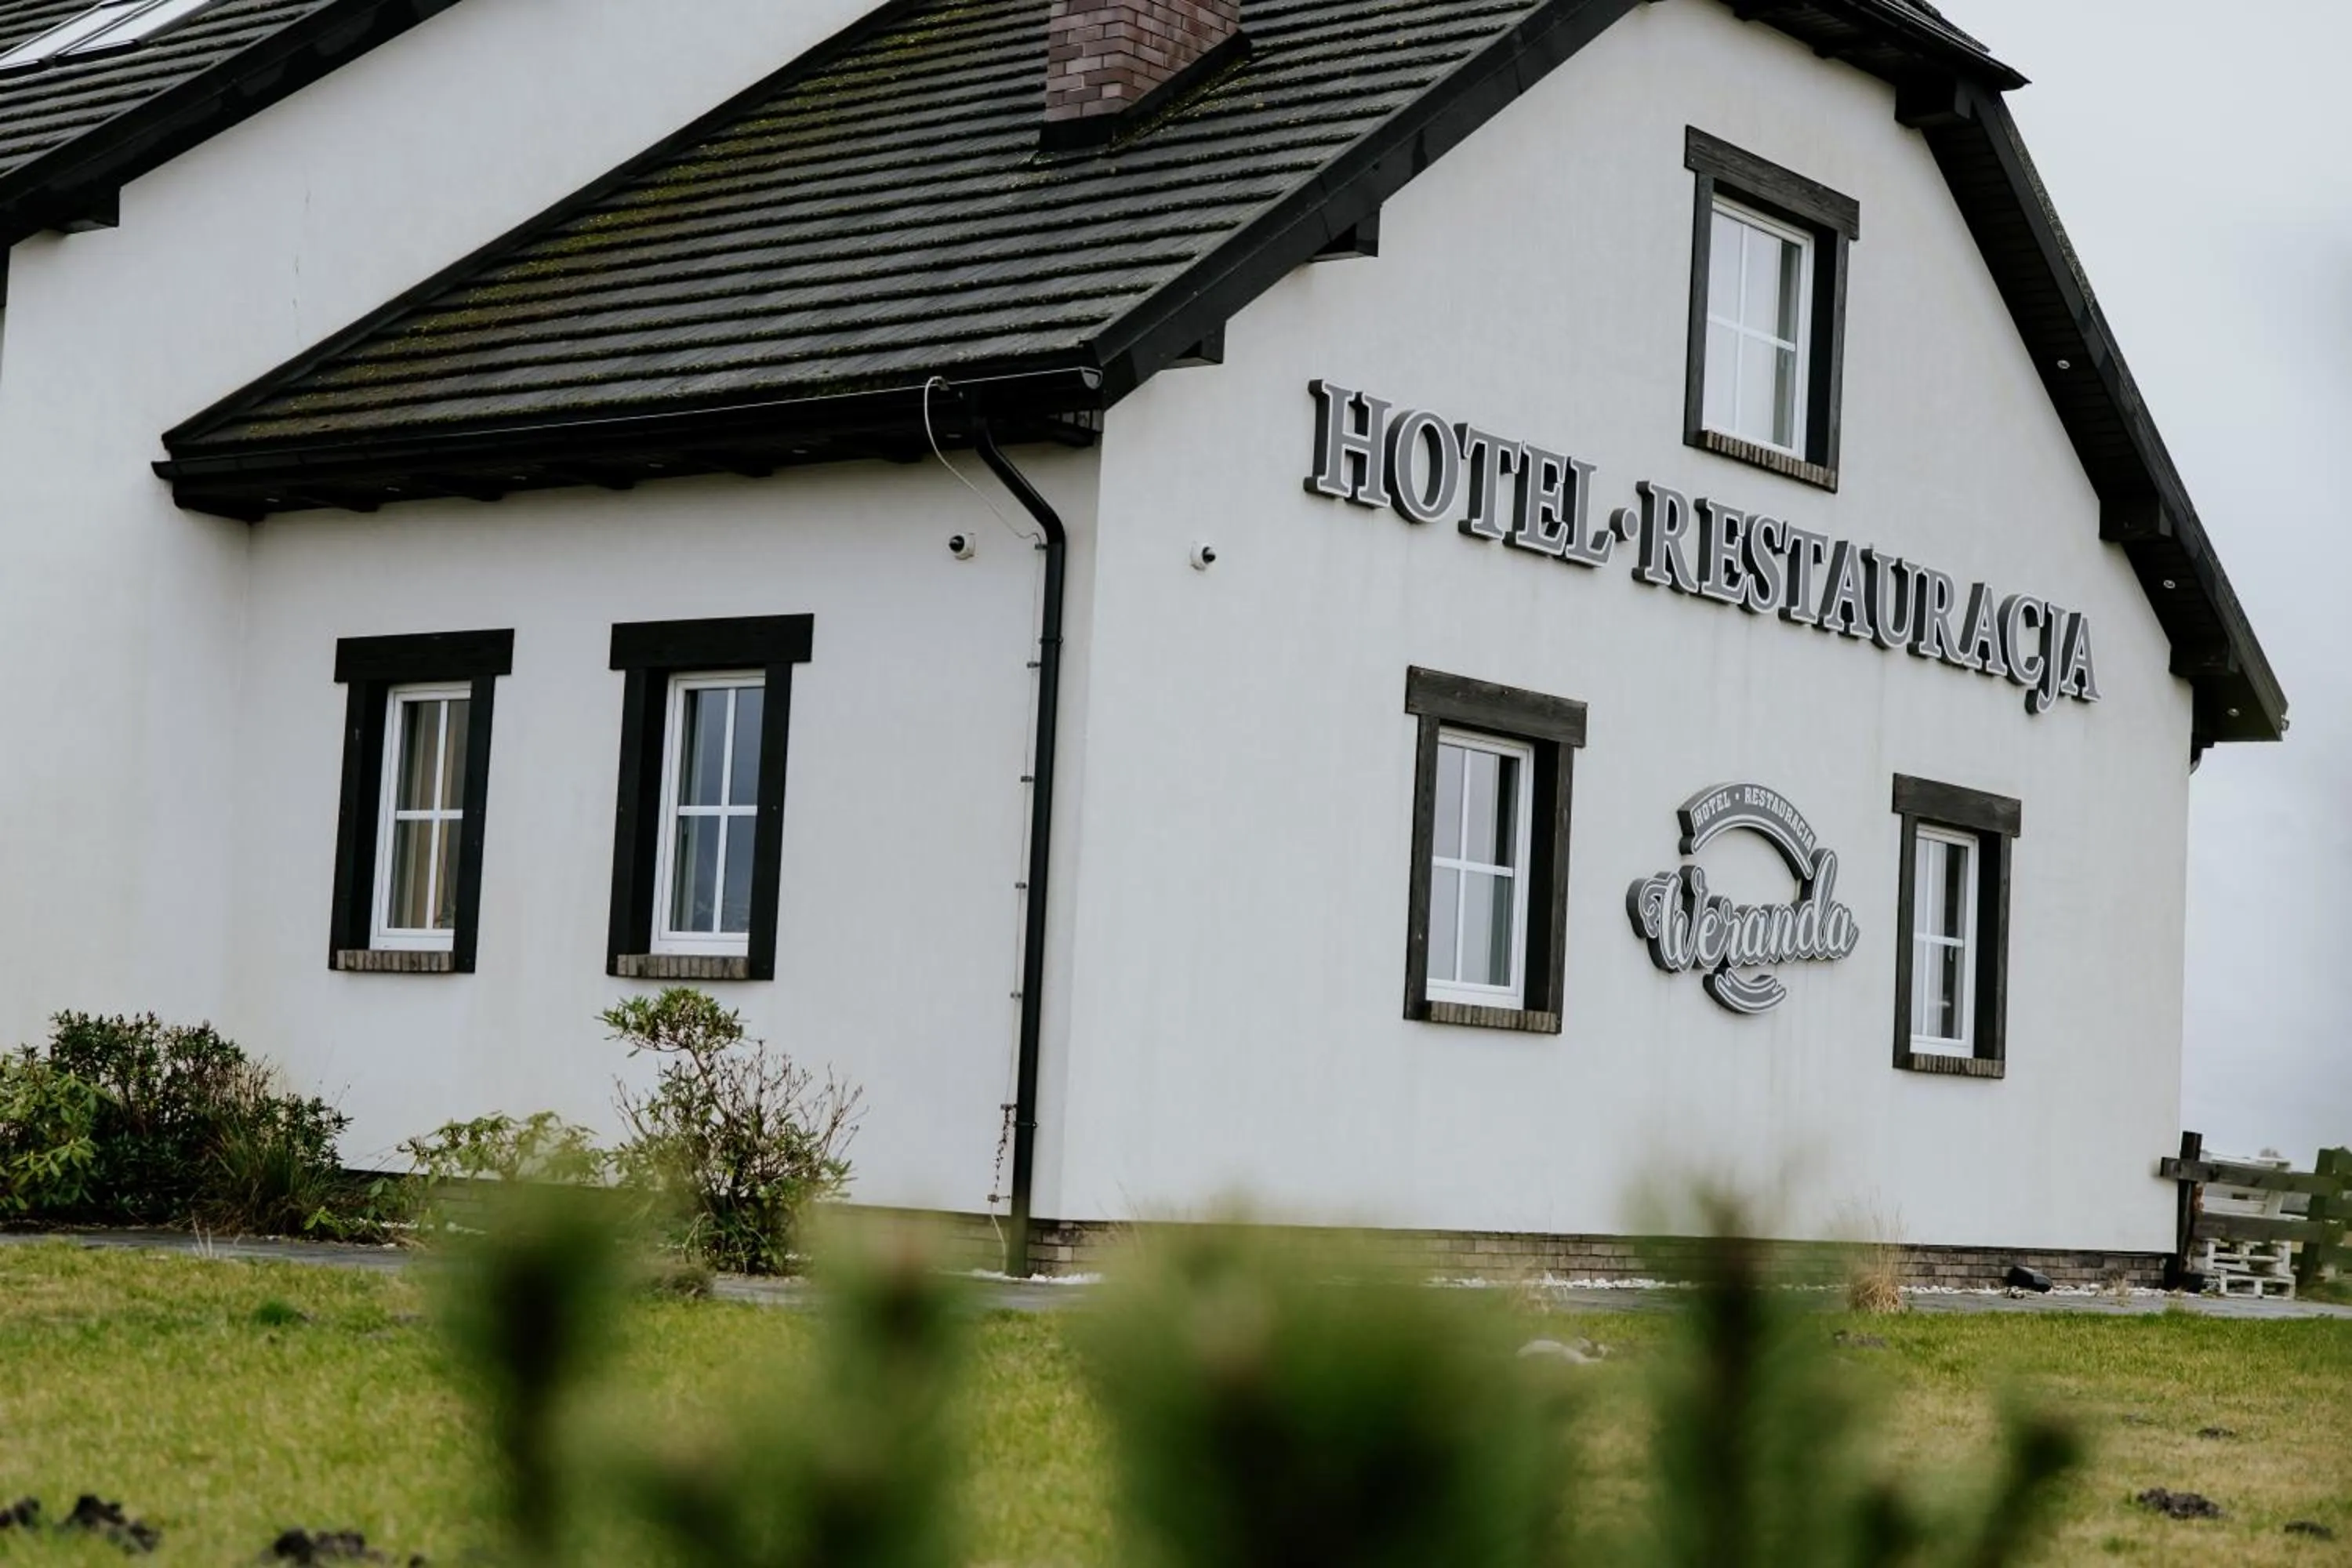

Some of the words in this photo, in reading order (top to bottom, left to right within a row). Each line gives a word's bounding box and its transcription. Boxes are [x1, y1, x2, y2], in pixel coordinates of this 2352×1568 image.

[1305, 379, 1614, 568] HOTEL
[1632, 481, 2102, 714] RESTAURACJA
[1693, 791, 1731, 826] HOTEL
[1744, 786, 1814, 851] RESTAURACJA
[1635, 848, 1859, 971] Weranda
